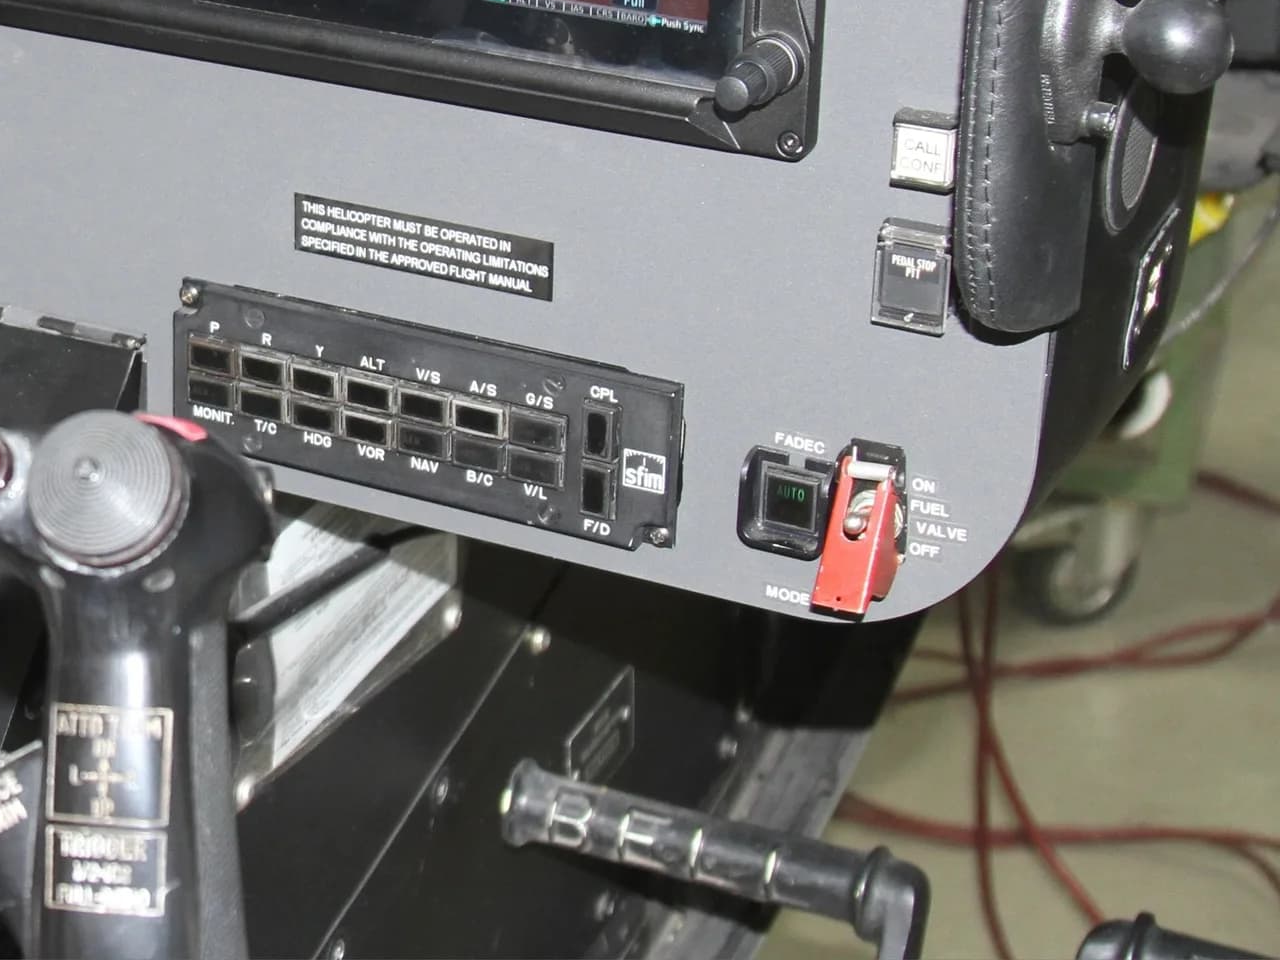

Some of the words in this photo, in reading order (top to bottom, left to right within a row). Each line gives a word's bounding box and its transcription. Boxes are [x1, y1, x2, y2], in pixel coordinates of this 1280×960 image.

[661, 18, 681, 29] Push
[683, 21, 704, 33] Sync
[904, 139, 941, 157] CALL
[302, 201, 325, 215] THIS
[327, 205, 391, 228] HELICOPTER
[393, 219, 421, 234] MUST
[424, 225, 438, 238] BE
[440, 228, 497, 250] OPERATED
[499, 240, 511, 252] IN
[301, 218, 367, 241] COMPLIANCE
[368, 232, 396, 246] WITH
[398, 237, 418, 251] THE
[420, 242, 481, 264] OPERATING
[483, 254, 549, 277] LIMITATIONS
[301, 236, 354, 256] SPECIFIED
[356, 245, 367, 258] IN
[368, 248, 389, 263] THE
[391, 253, 448, 276] APPROVED
[449, 266, 486, 282] FLIGHT
[488, 273, 532, 292] MANUAL
[891, 254, 915, 267] PEDAL
[916, 259, 937, 272] STOP
[360, 357, 385, 371] ALT
[415, 368, 441, 384] V/S
[470, 381, 497, 396] A/S
[590, 386, 618, 403] CPL
[525, 393, 554, 409] G/S
[193, 405, 235, 424] MONIT.
[254, 420, 277, 434] T/C
[304, 432, 332, 448] HDG
[775, 432, 825, 454] FADEC
[357, 444, 385, 460] VOR
[411, 457, 439, 473] NAV
[466, 470, 494, 486] B/C
[625, 466, 663, 490] sfim
[912, 478, 936, 493] ON
[523, 484, 548, 500] V/L
[777, 485, 805, 502] AUTO
[911, 500, 949, 517] FUEL
[583, 519, 610, 535] F/D
[916, 522, 967, 541] VALVE
[909, 543, 940, 557] OFF
[766, 585, 810, 606] MODE
